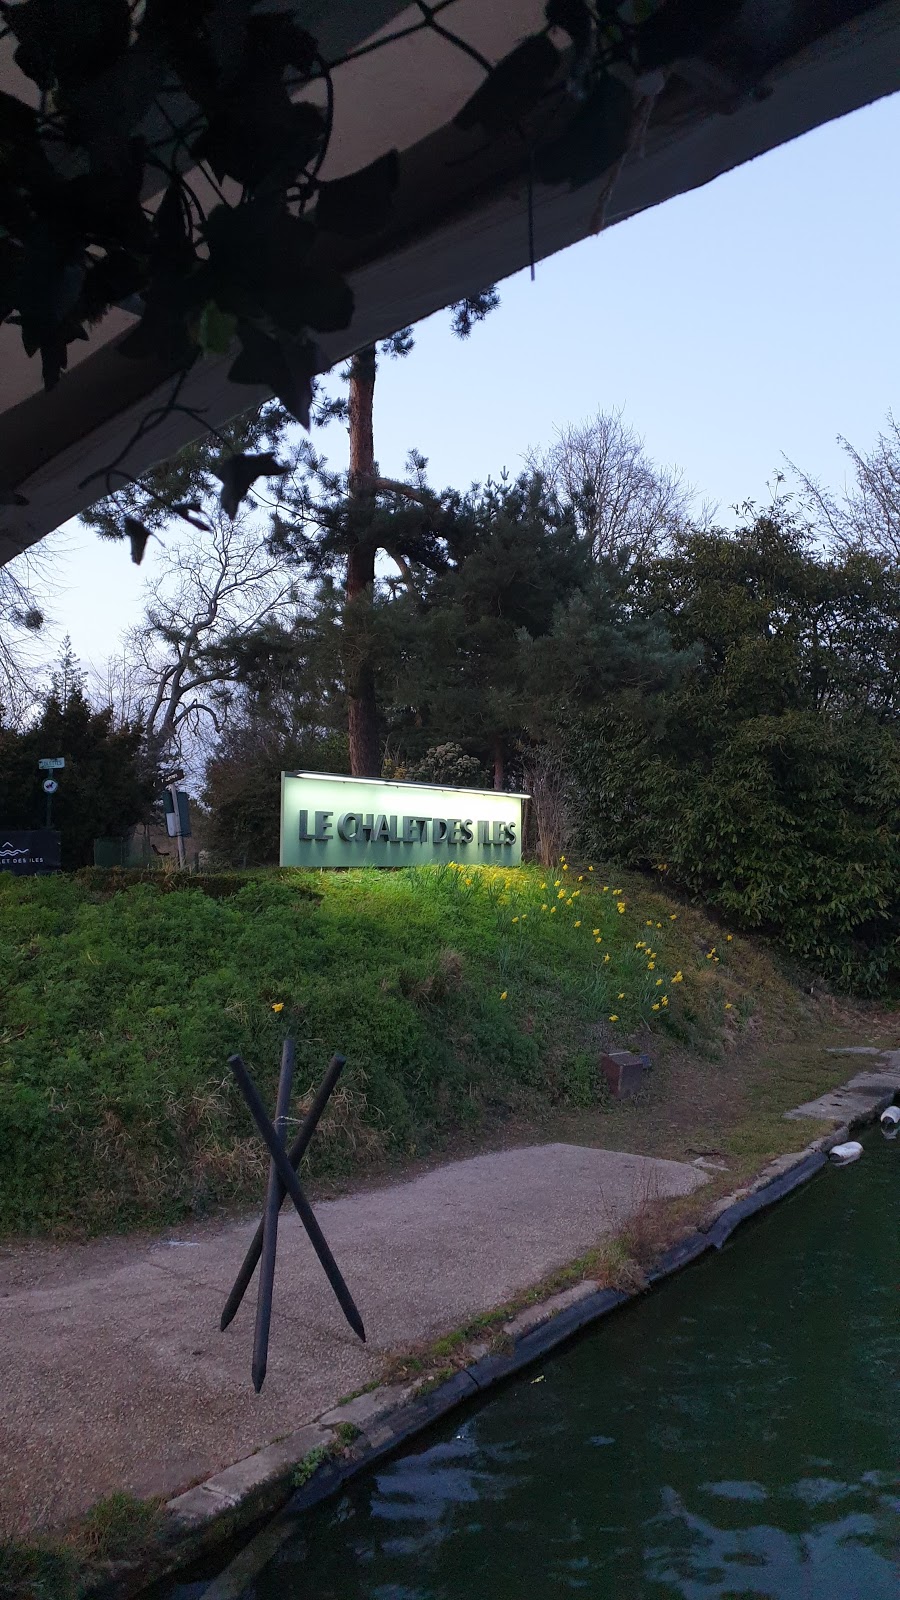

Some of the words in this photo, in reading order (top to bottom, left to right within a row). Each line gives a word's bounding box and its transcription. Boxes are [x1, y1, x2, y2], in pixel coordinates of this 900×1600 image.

[299, 810, 333, 841] LE
[338, 812, 432, 843] CHALET
[433, 818, 473, 844] DES
[478, 820, 516, 846] ILES
